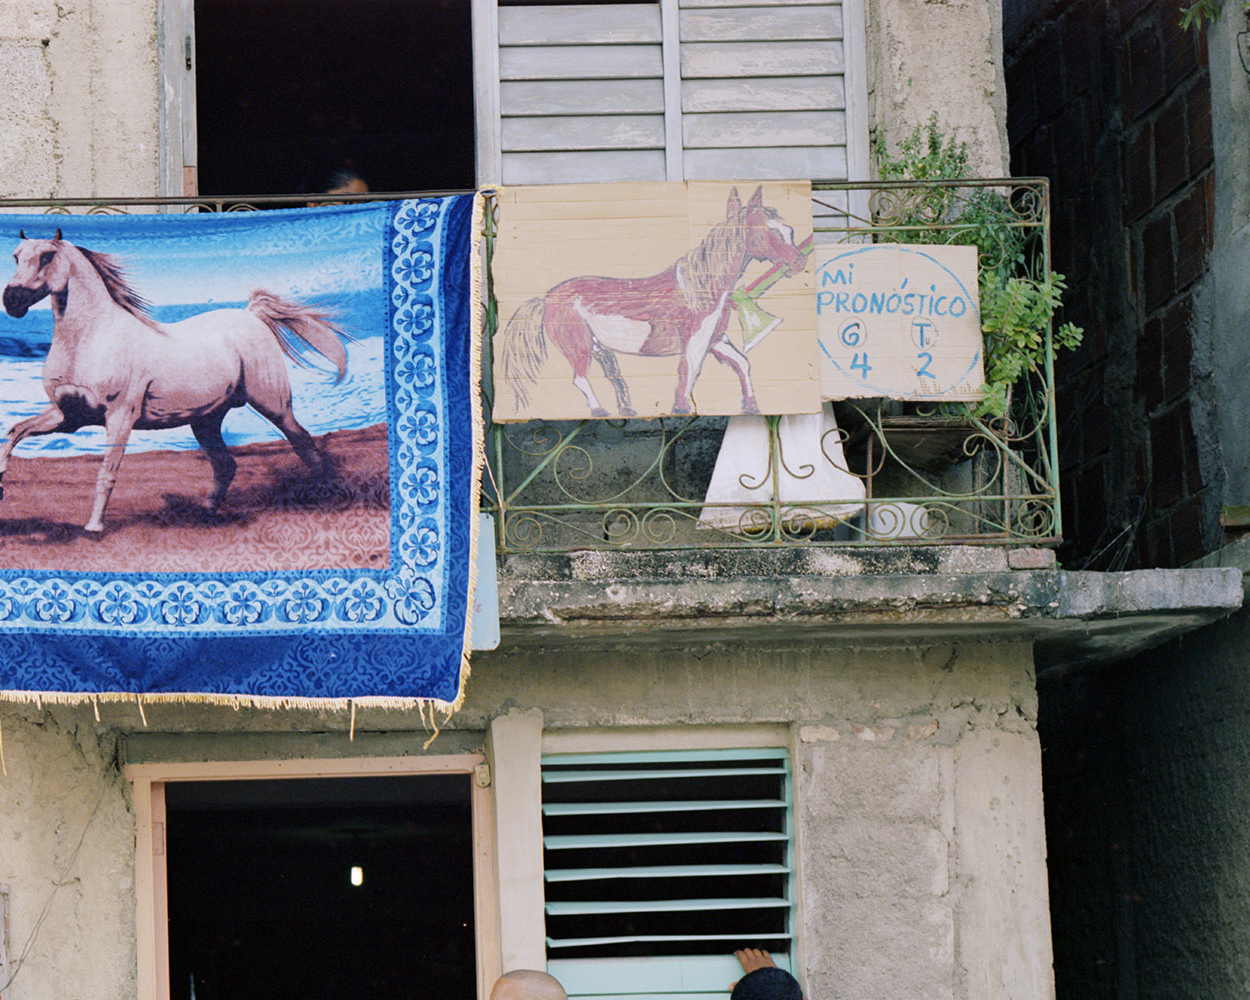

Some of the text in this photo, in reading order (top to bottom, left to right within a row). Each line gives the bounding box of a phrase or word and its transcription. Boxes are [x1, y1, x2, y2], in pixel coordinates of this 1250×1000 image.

[816, 277, 966, 318] PRONÓSTICO
[841, 322, 861, 347] G
[850, 352, 936, 380] 4 2
